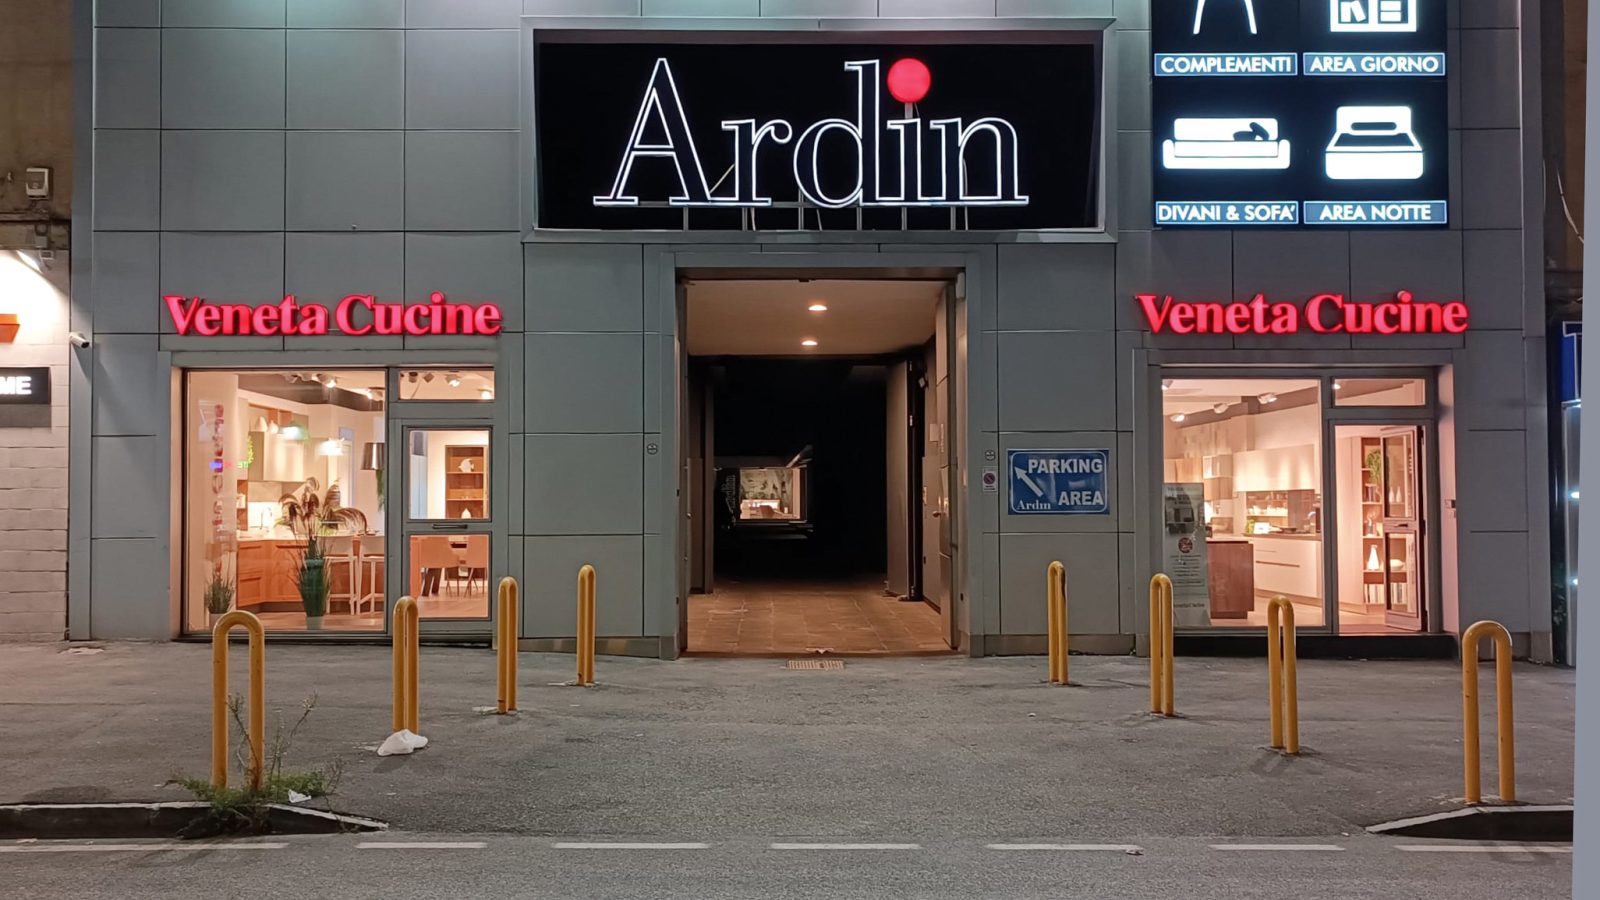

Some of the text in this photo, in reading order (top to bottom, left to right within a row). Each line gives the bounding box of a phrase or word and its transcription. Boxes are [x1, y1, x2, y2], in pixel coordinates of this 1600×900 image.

[1160, 56, 1292, 74] COMPLEMENTI
[1309, 56, 1440, 74] AREA GIORNO
[593, 58, 1029, 209] Ardin
[1158, 204, 1221, 221] DIVANI
[1225, 204, 1241, 221] &
[1319, 205, 1432, 221] AREA NOTTE
[163, 291, 503, 336] Veneta Cucine
[1135, 290, 1470, 334] Veneta Cucine
[1028, 458, 1104, 474] PARKING
[1058, 491, 1105, 506] AREA
